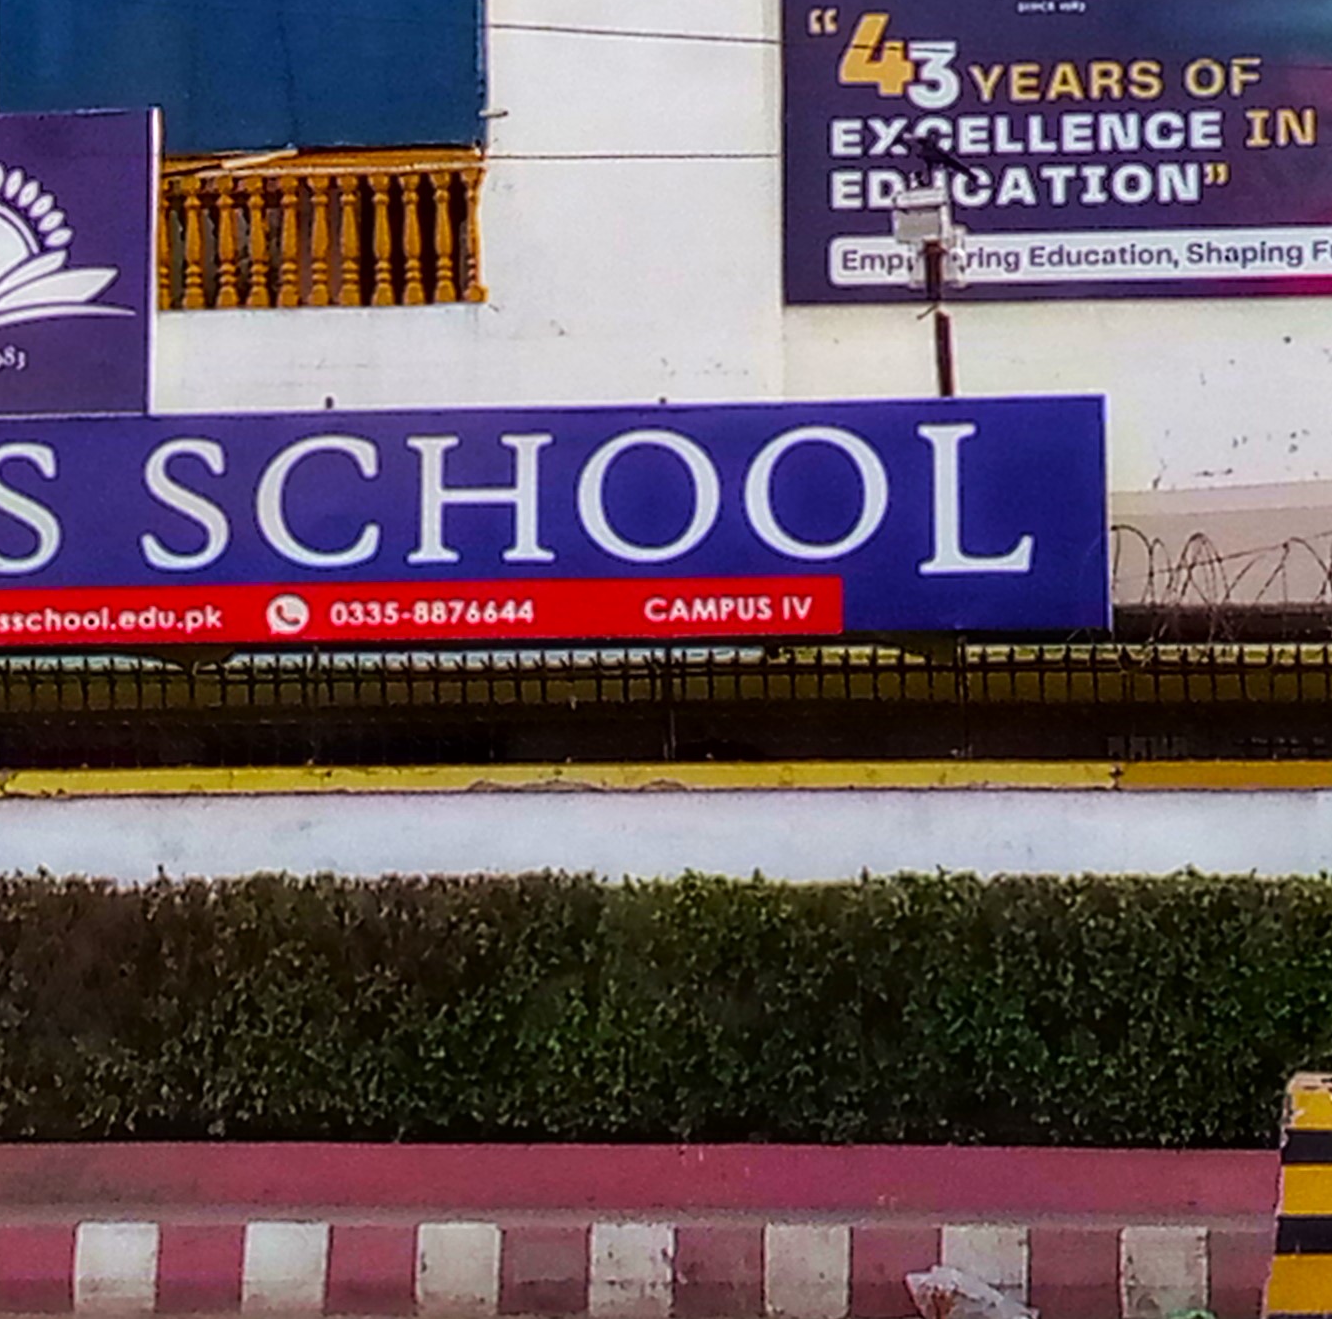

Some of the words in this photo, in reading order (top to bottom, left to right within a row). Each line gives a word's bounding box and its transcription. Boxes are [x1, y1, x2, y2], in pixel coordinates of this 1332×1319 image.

[969, 61, 1163, 102] YEARS
[1184, 57, 1262, 97] OF
[1245, 108, 1317, 146] IN
[1029, 239, 1181, 267] Education,
[1186, 238, 1304, 266] Shaping
[141, 423, 1035, 575] SCHOOL
[329, 598, 536, 626] 0335-8876644
[643, 595, 773, 623] CAMPUS
[782, 595, 814, 620] IV
